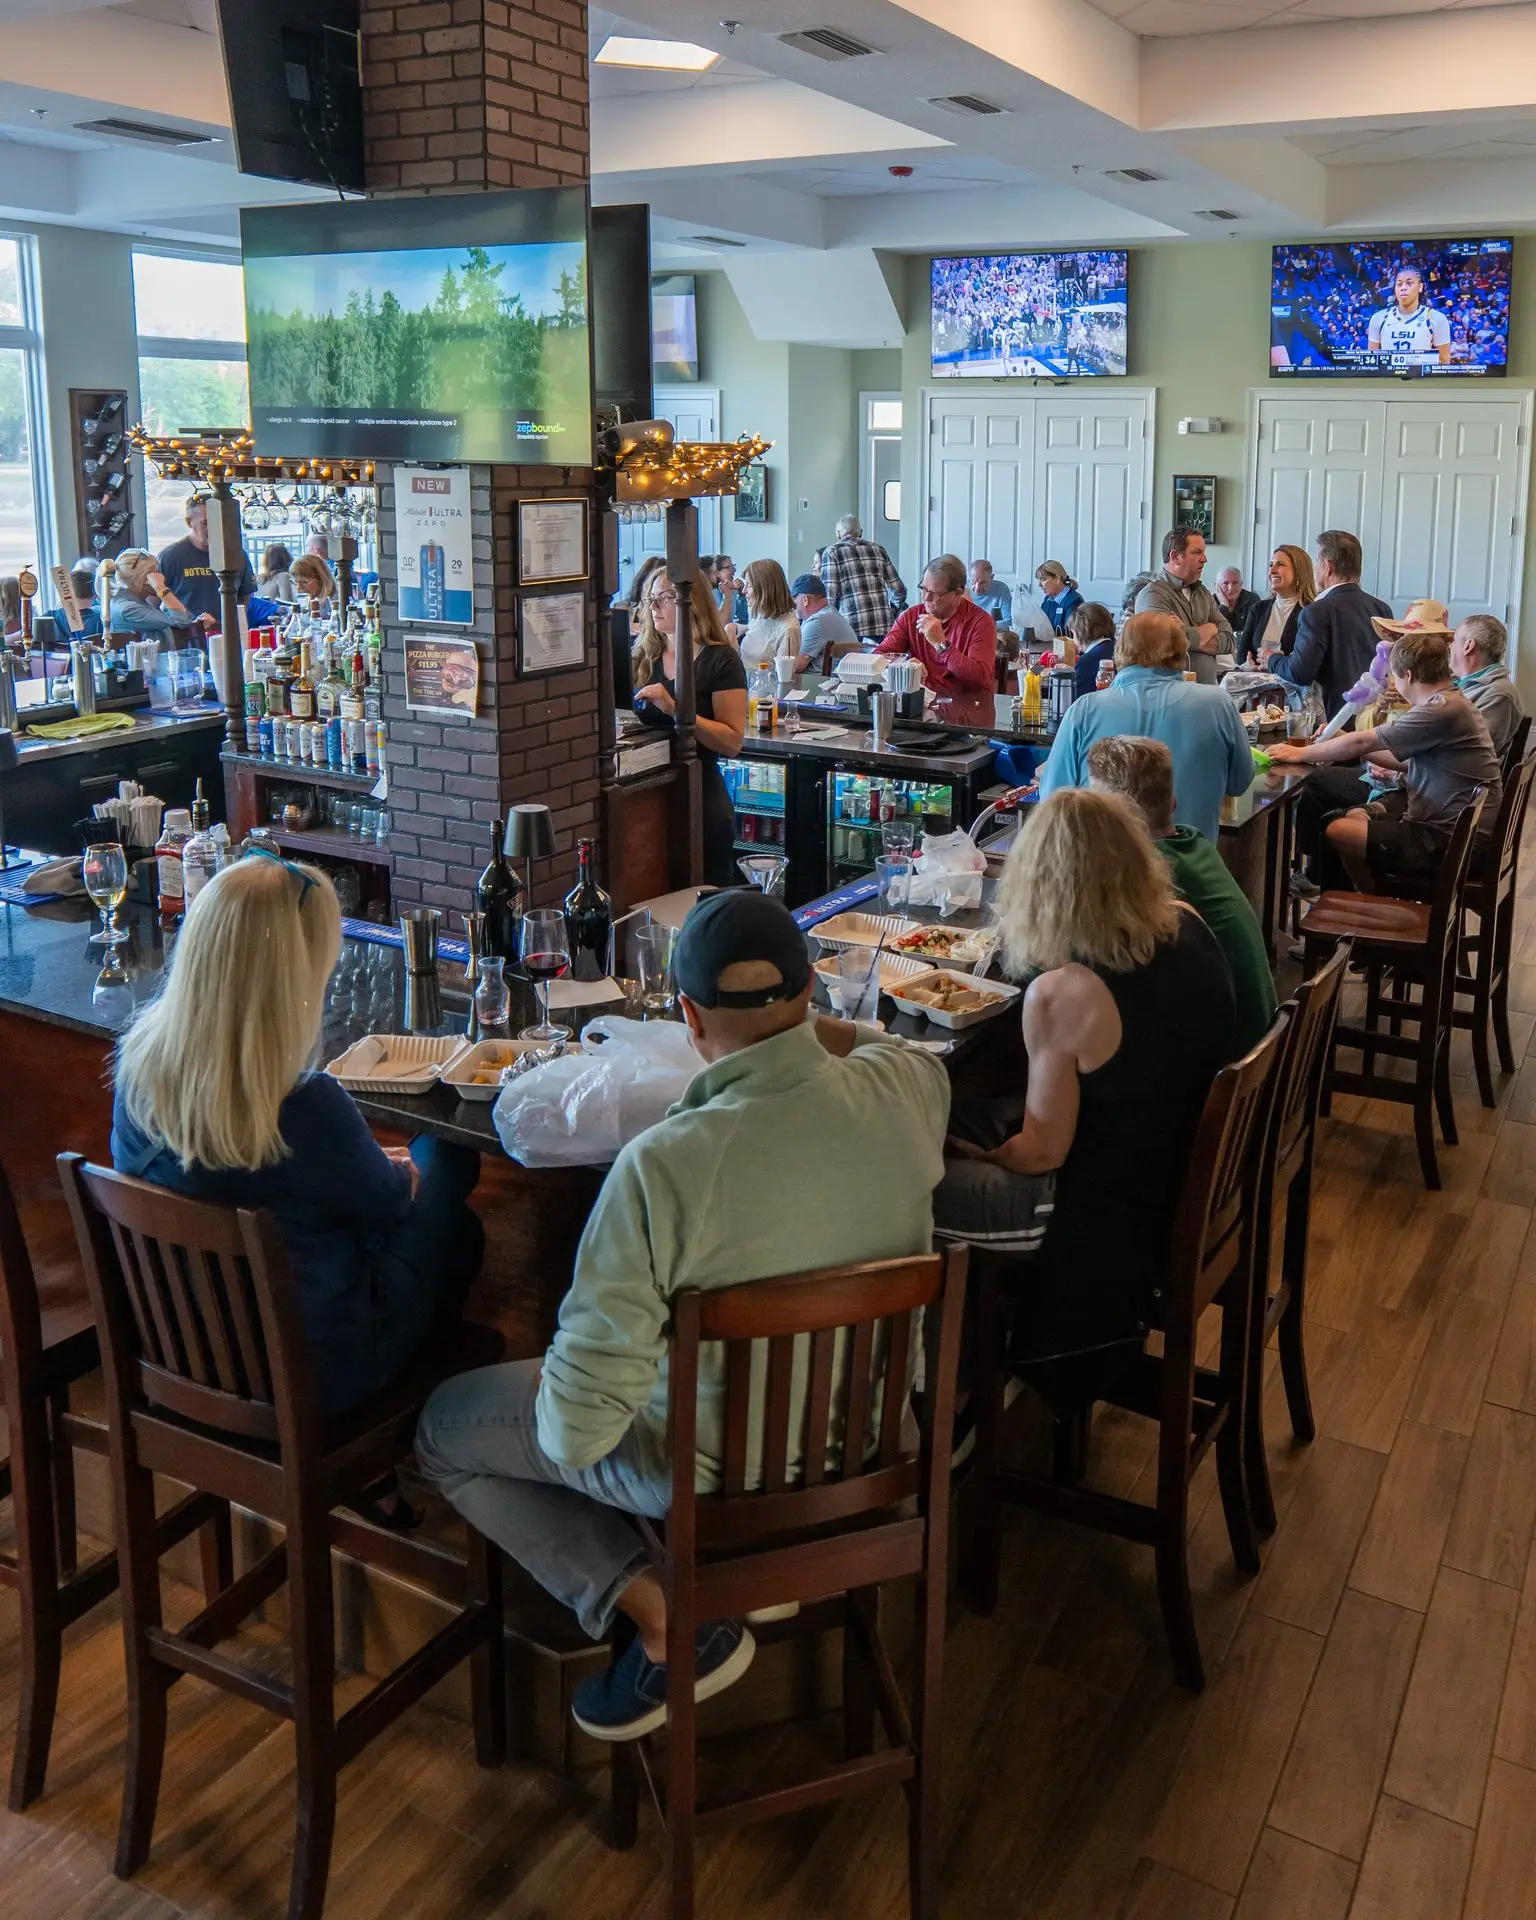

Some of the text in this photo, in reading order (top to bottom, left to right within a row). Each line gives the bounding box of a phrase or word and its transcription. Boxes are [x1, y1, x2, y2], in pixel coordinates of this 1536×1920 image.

[1391, 331, 1415, 339] LSU
[1365, 356, 1375, 364] 36
[420, 419, 441, 427] syndrome
[516, 422, 560, 434] zepbound
[417, 480, 445, 491] NEW
[434, 508, 463, 518] ULTRA
[451, 559, 463, 569] 29
[183, 567, 212, 577] NOTRE
[58, 568, 70, 596] ULTRA
[428, 568, 437, 619] ULTRA
[418, 660, 438, 669] $11.95
[813, 895, 853, 914] ULTRA
